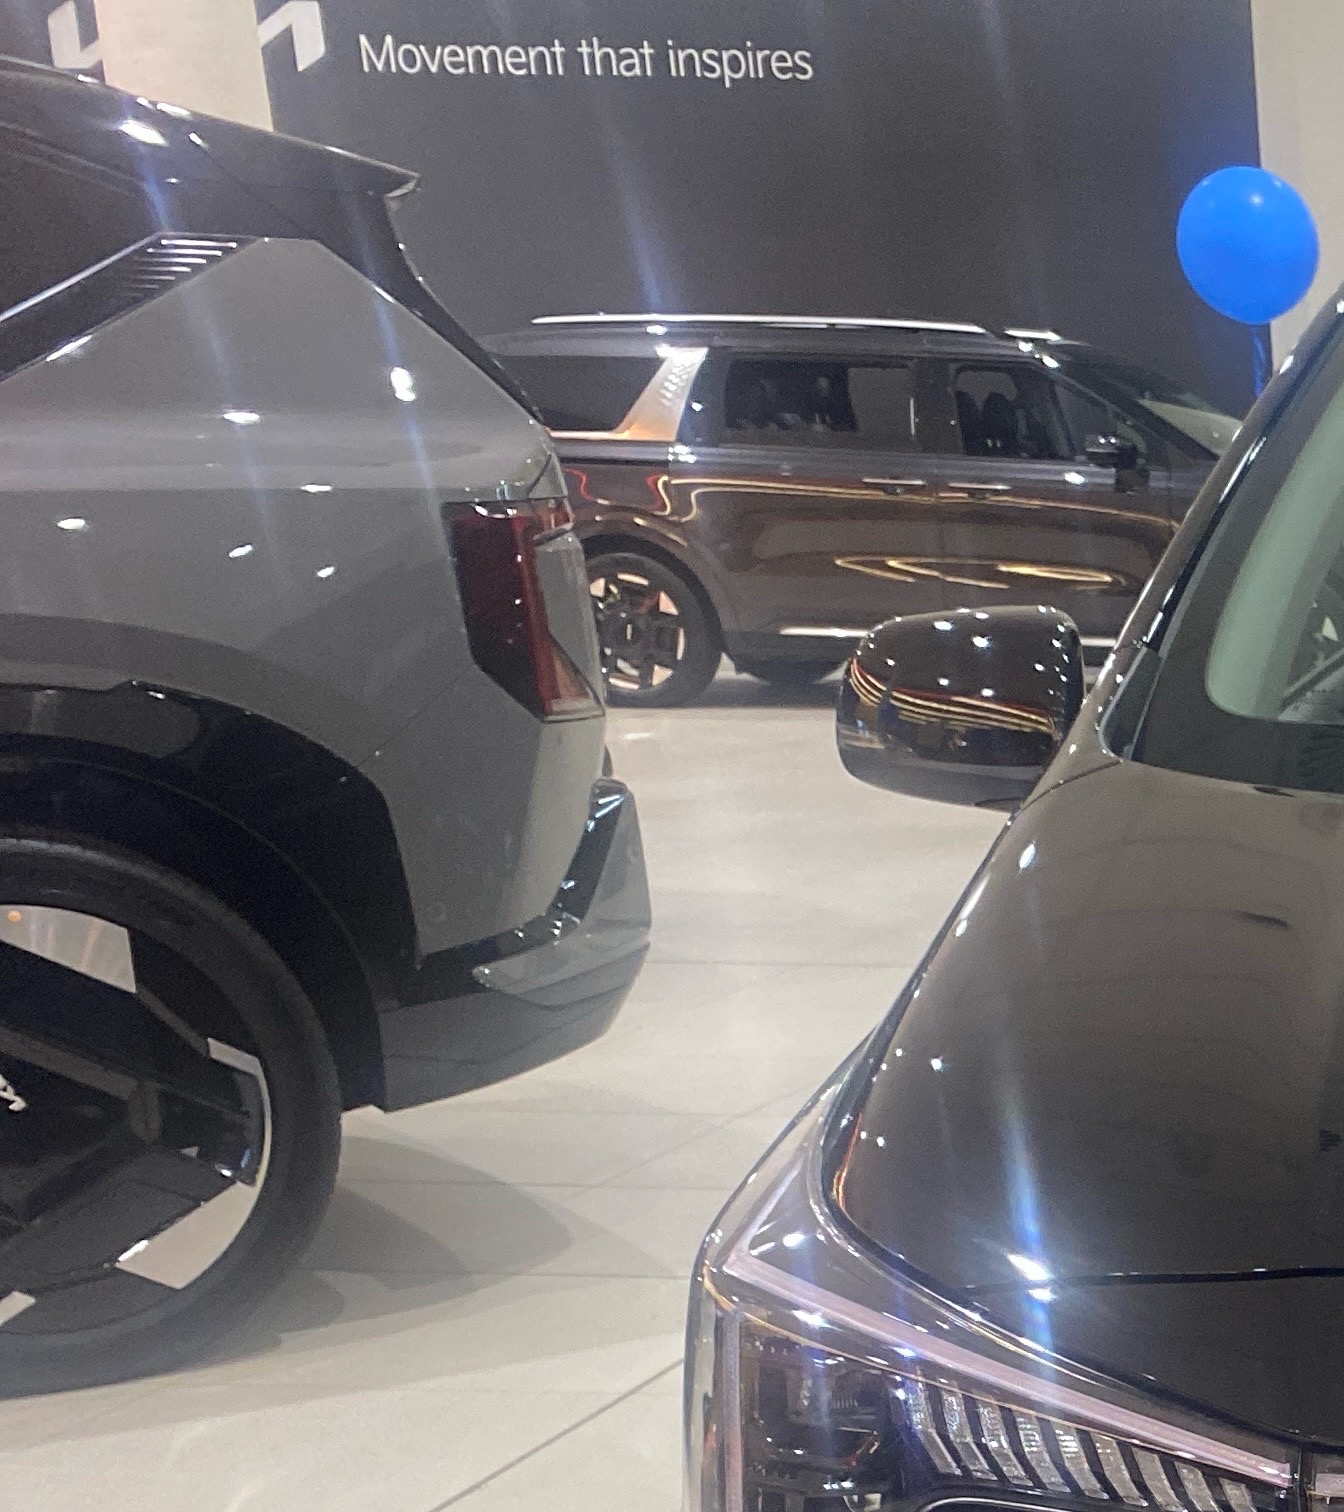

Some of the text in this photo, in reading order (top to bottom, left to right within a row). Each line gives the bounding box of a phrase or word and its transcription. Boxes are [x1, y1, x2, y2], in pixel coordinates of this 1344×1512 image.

[359, 33, 566, 76] Movement
[577, 36, 655, 78] that
[666, 39, 815, 88] inspires
